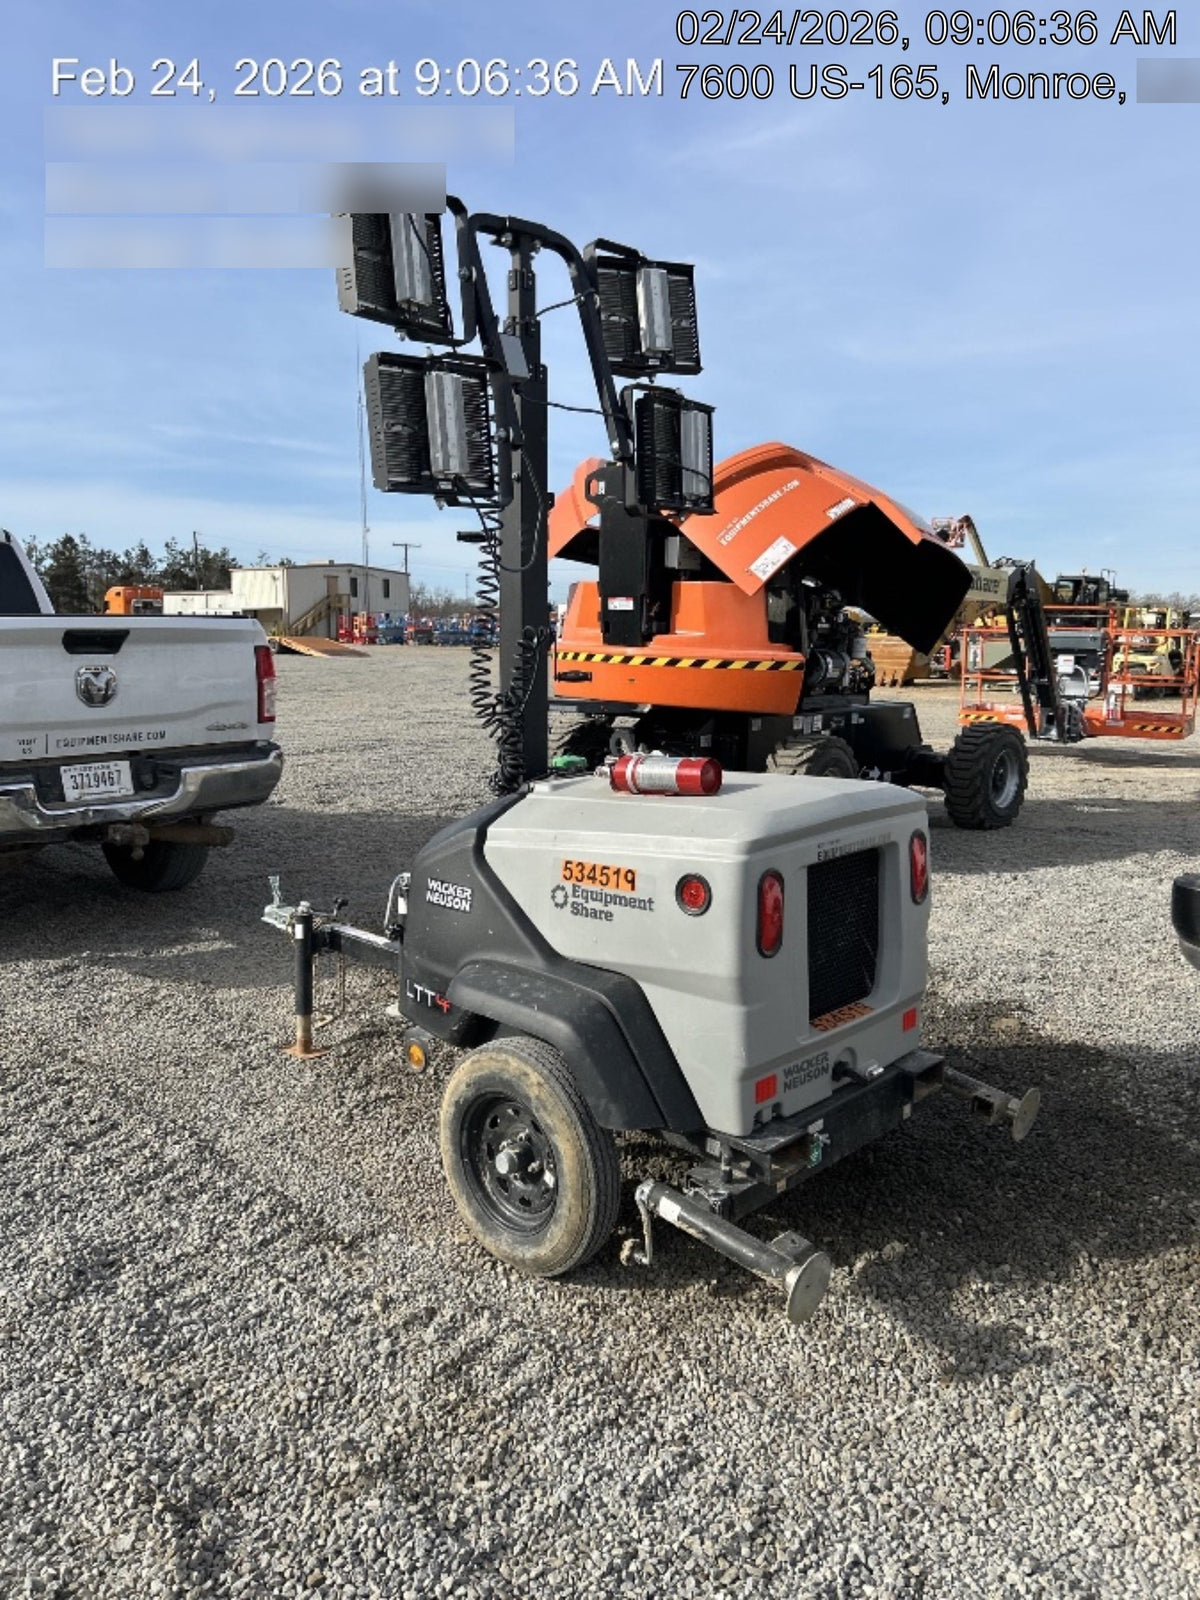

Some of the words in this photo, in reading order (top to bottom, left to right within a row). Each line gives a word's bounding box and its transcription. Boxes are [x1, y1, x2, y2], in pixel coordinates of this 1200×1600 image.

[56, 730, 166, 748] EQUIPMENTSHARE.COM
[427, 877, 472, 900] WACKER
[562, 860, 636, 891] 534519
[425, 890, 471, 912] NEUSON
[570, 901, 614, 921] Share
[571, 883, 655, 912] Equipment
[406, 979, 450, 1013] LTT4
[783, 1051, 829, 1079] WACKER
[783, 1063, 829, 1093] NEUSON
